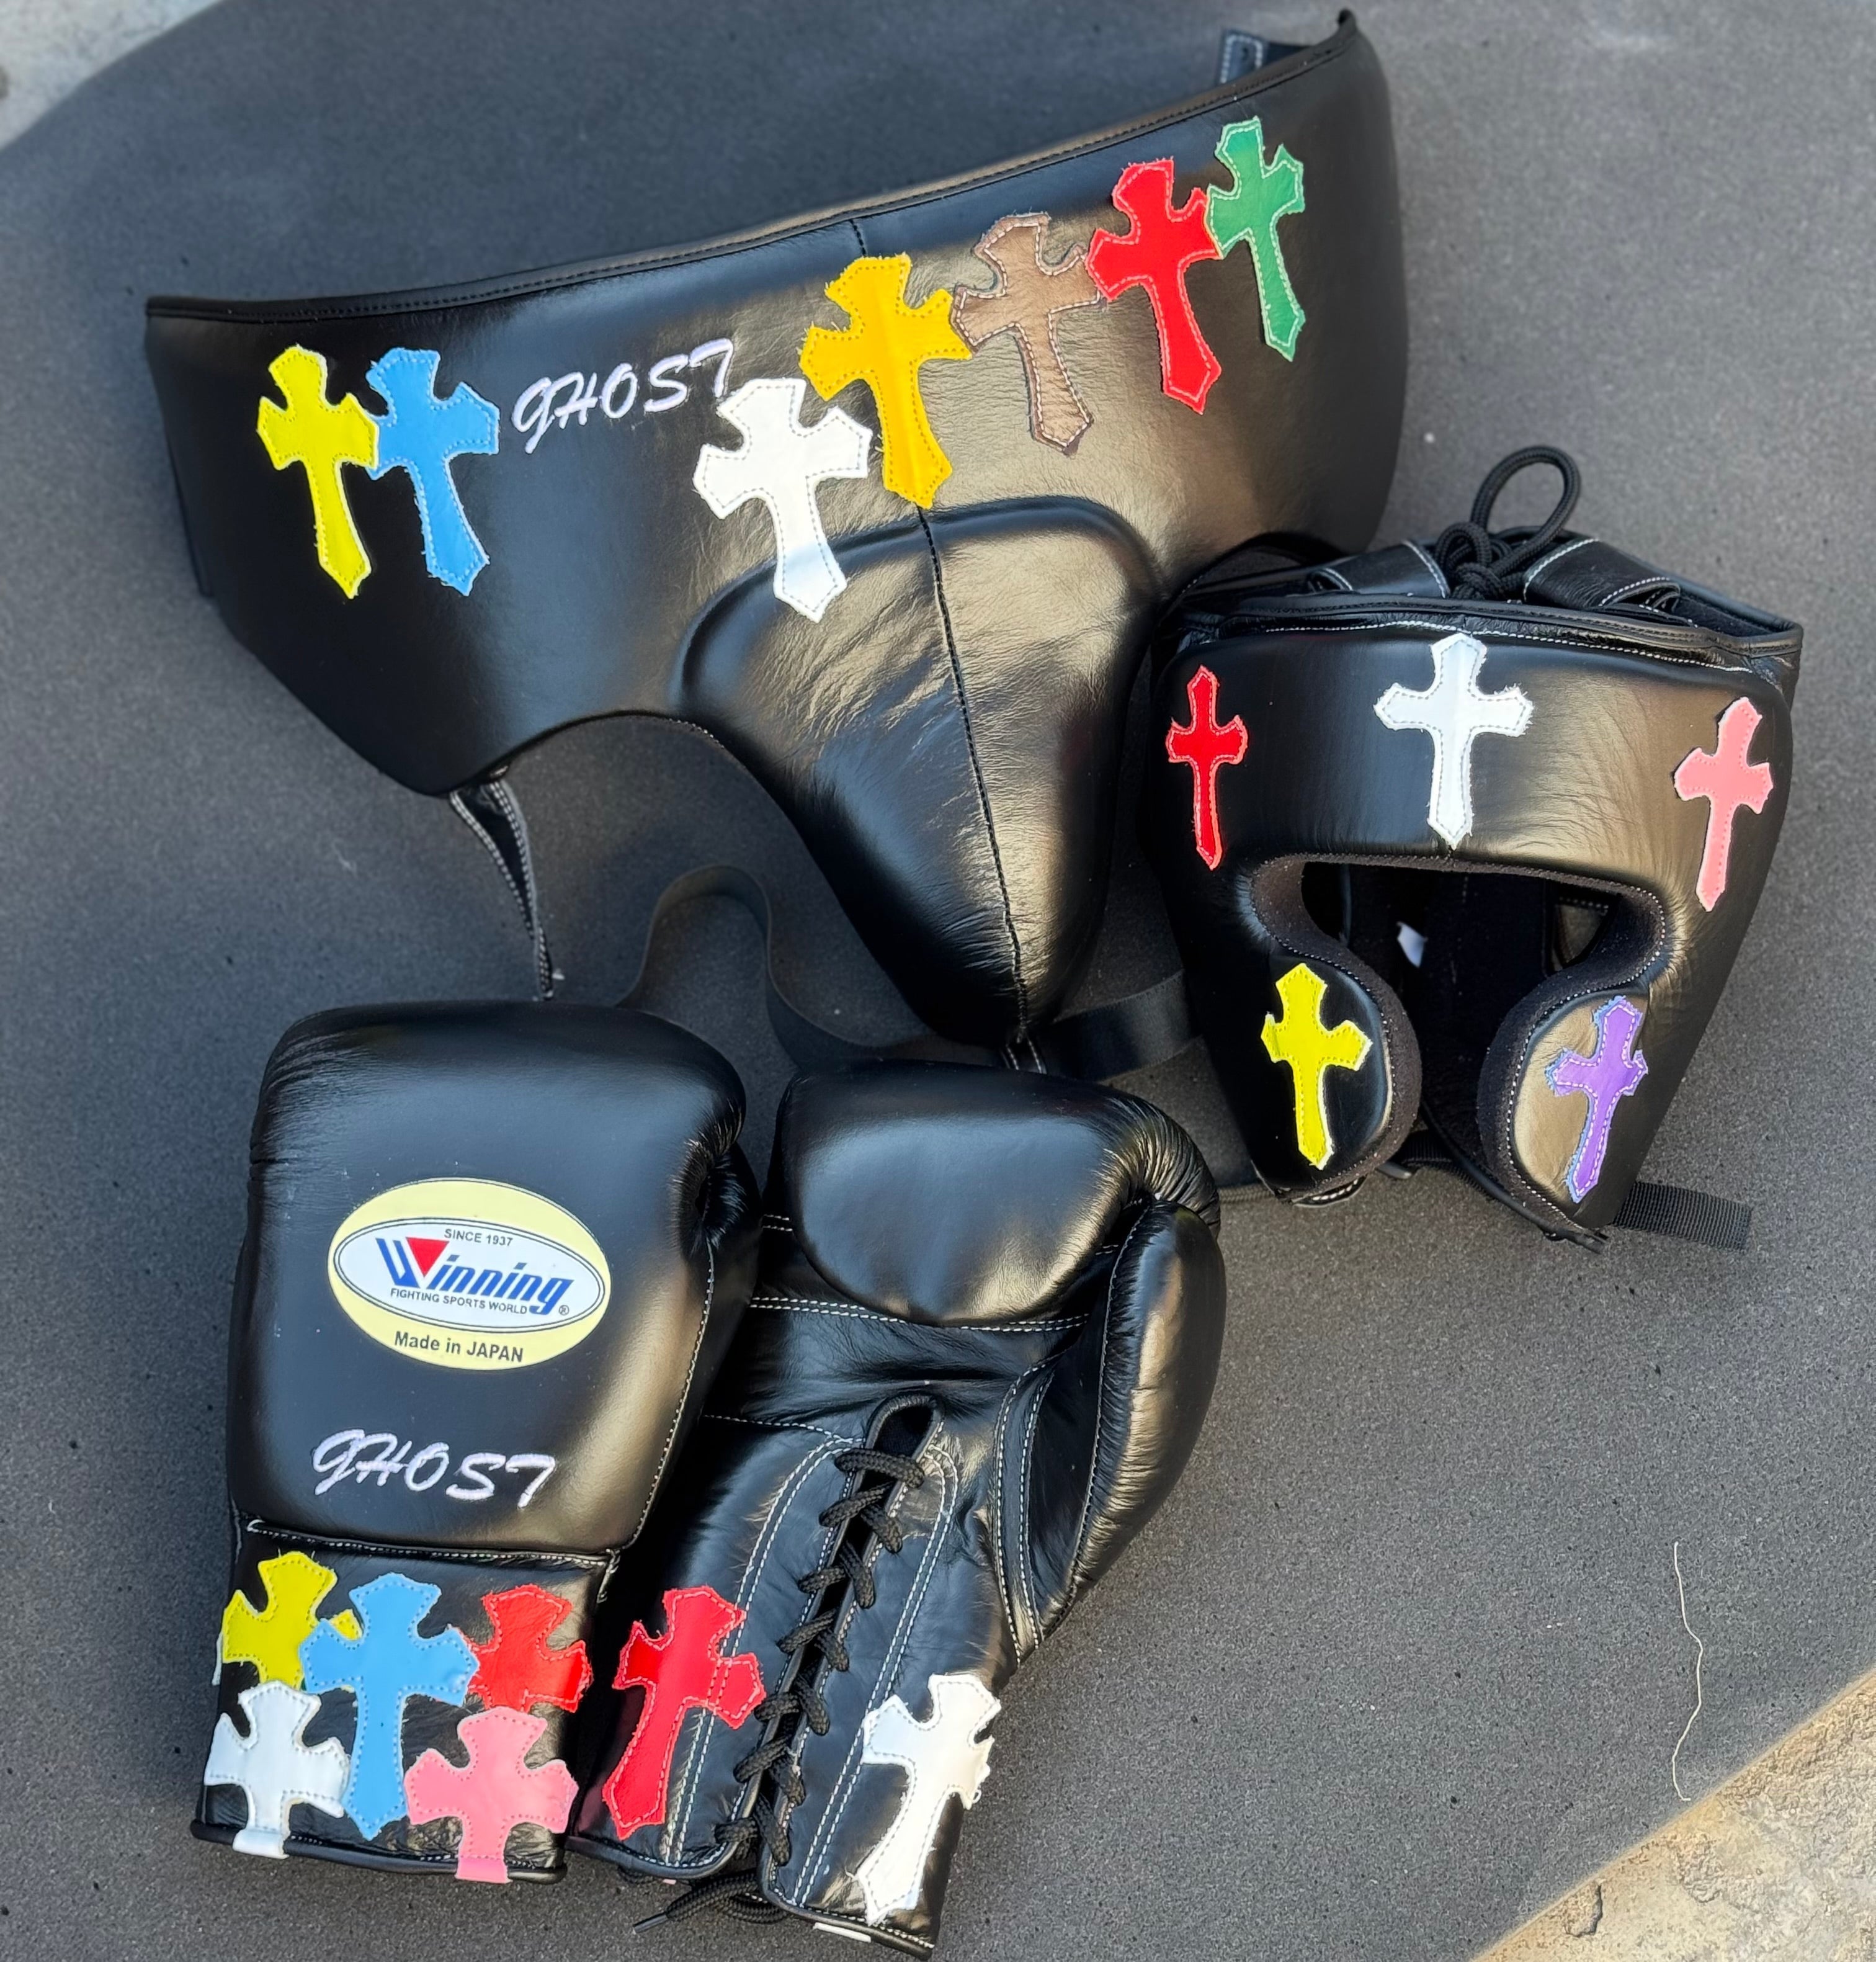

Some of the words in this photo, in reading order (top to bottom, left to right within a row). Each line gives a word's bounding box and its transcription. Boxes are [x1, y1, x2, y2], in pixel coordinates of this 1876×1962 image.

[444, 1228, 481, 1243] SINCE
[486, 1235, 514, 1247] 1937
[375, 1237, 575, 1315] Winning
[390, 1288, 440, 1304] FIGHTING
[442, 1296, 486, 1310] SPORTS
[488, 1302, 528, 1315] WORLD
[395, 1331, 440, 1351] Made
[446, 1338, 461, 1355] in
[467, 1342, 524, 1363] JAPAN
